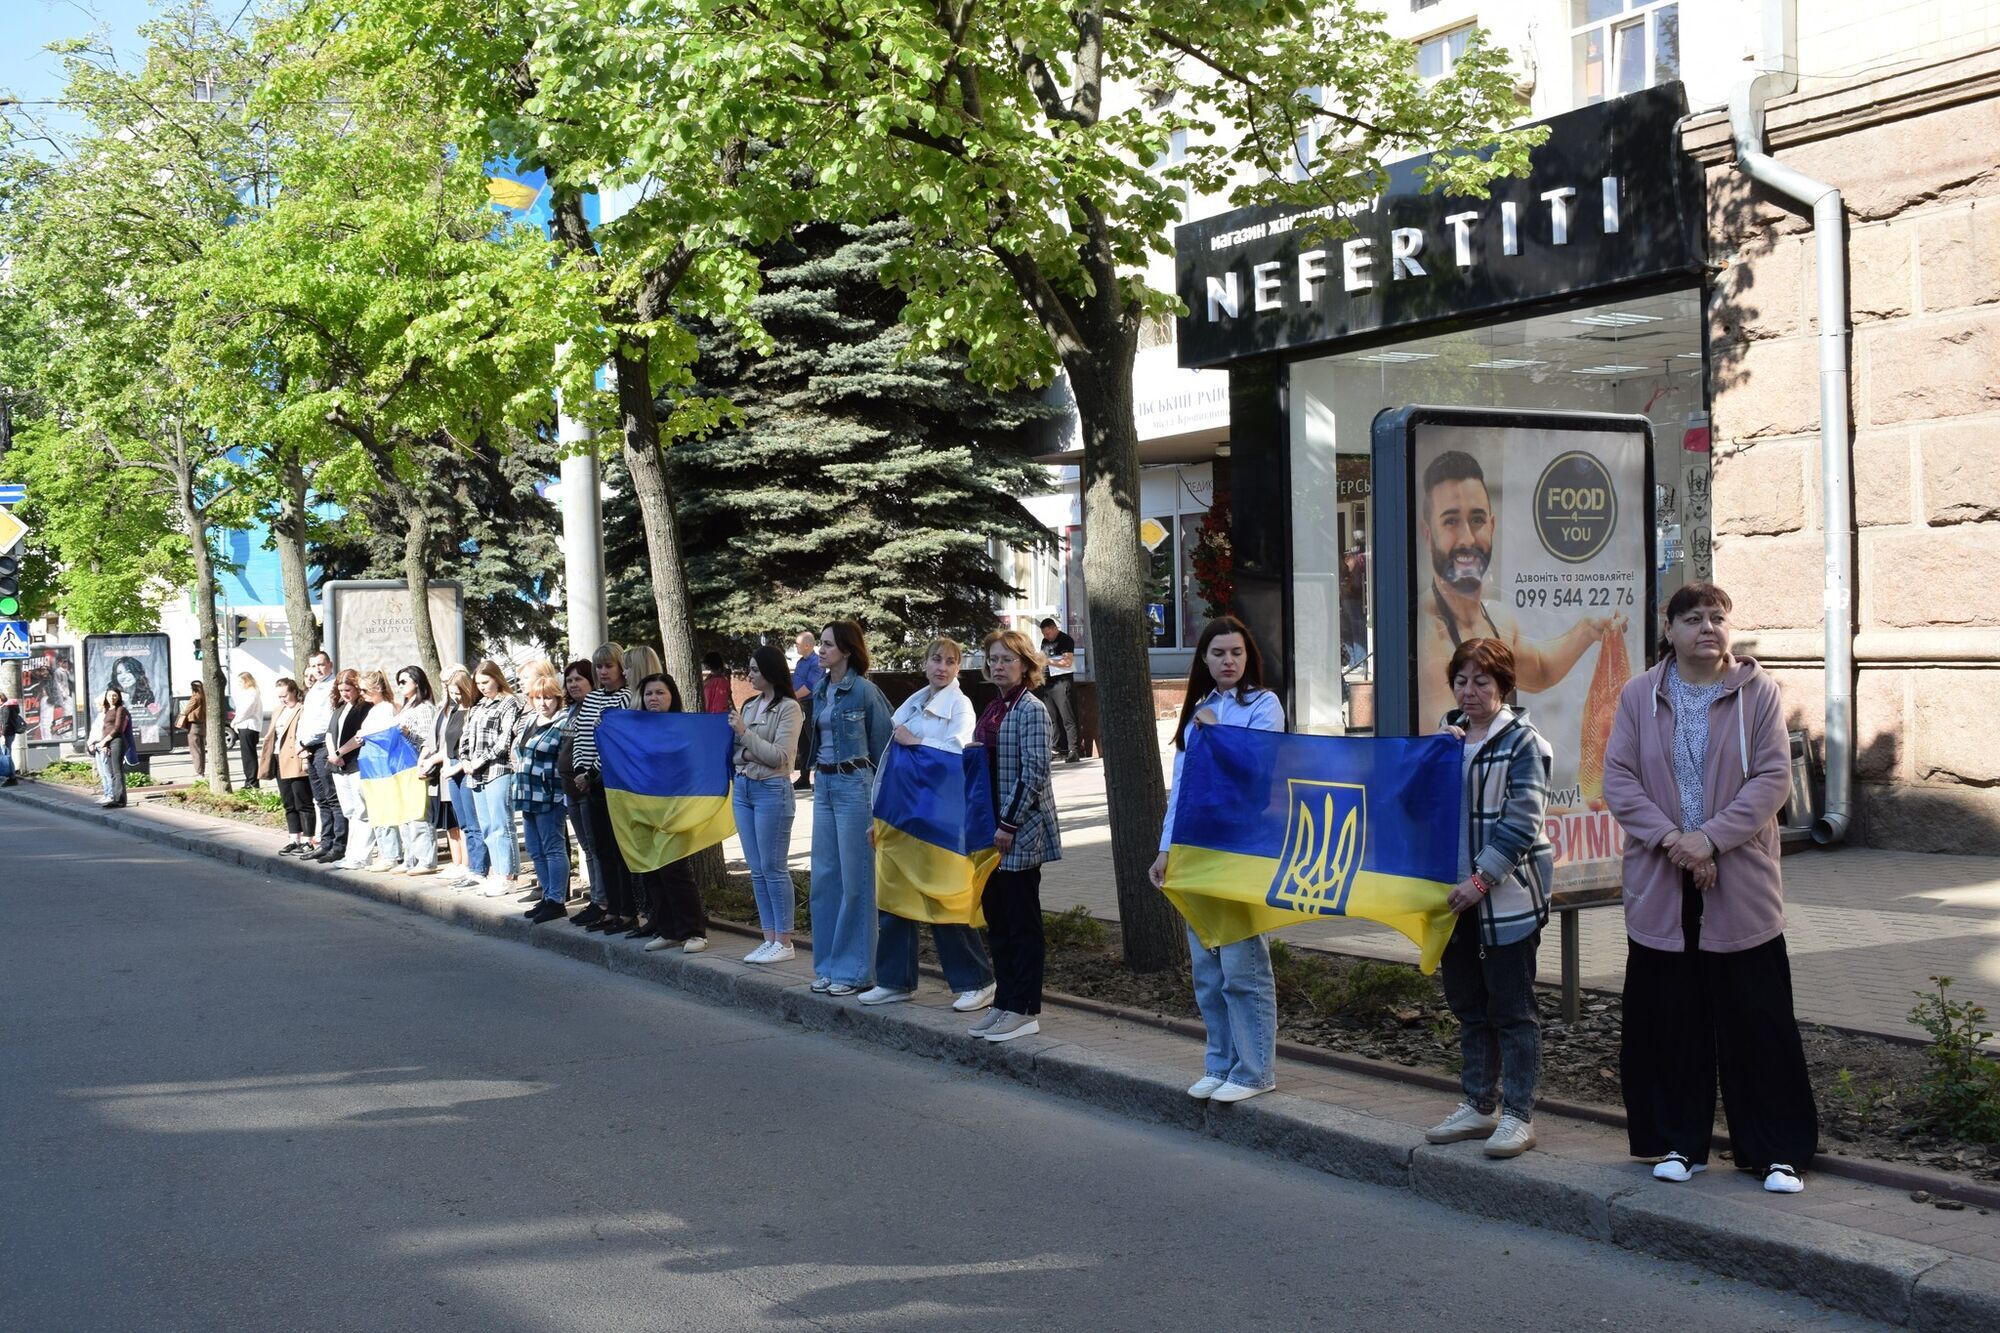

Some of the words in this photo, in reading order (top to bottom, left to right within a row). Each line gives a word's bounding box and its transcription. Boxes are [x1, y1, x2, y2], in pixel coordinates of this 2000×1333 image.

[1211, 222, 1266, 251] магазин
[1206, 175, 1620, 323] NEFERTITI
[1547, 487, 1606, 511] FOOD
[1571, 510, 1579, 523] 4
[1561, 527, 1592, 542] YOU
[1515, 571, 1559, 584] Дзвоніть
[1561, 573, 1573, 582] та
[1574, 570, 1635, 582] замовляйте!
[1515, 588, 1548, 609] 099
[1552, 587, 1584, 608] 544
[1587, 587, 1611, 607] 22
[1615, 587, 1635, 606] 76
[1550, 784, 1581, 809] му!
